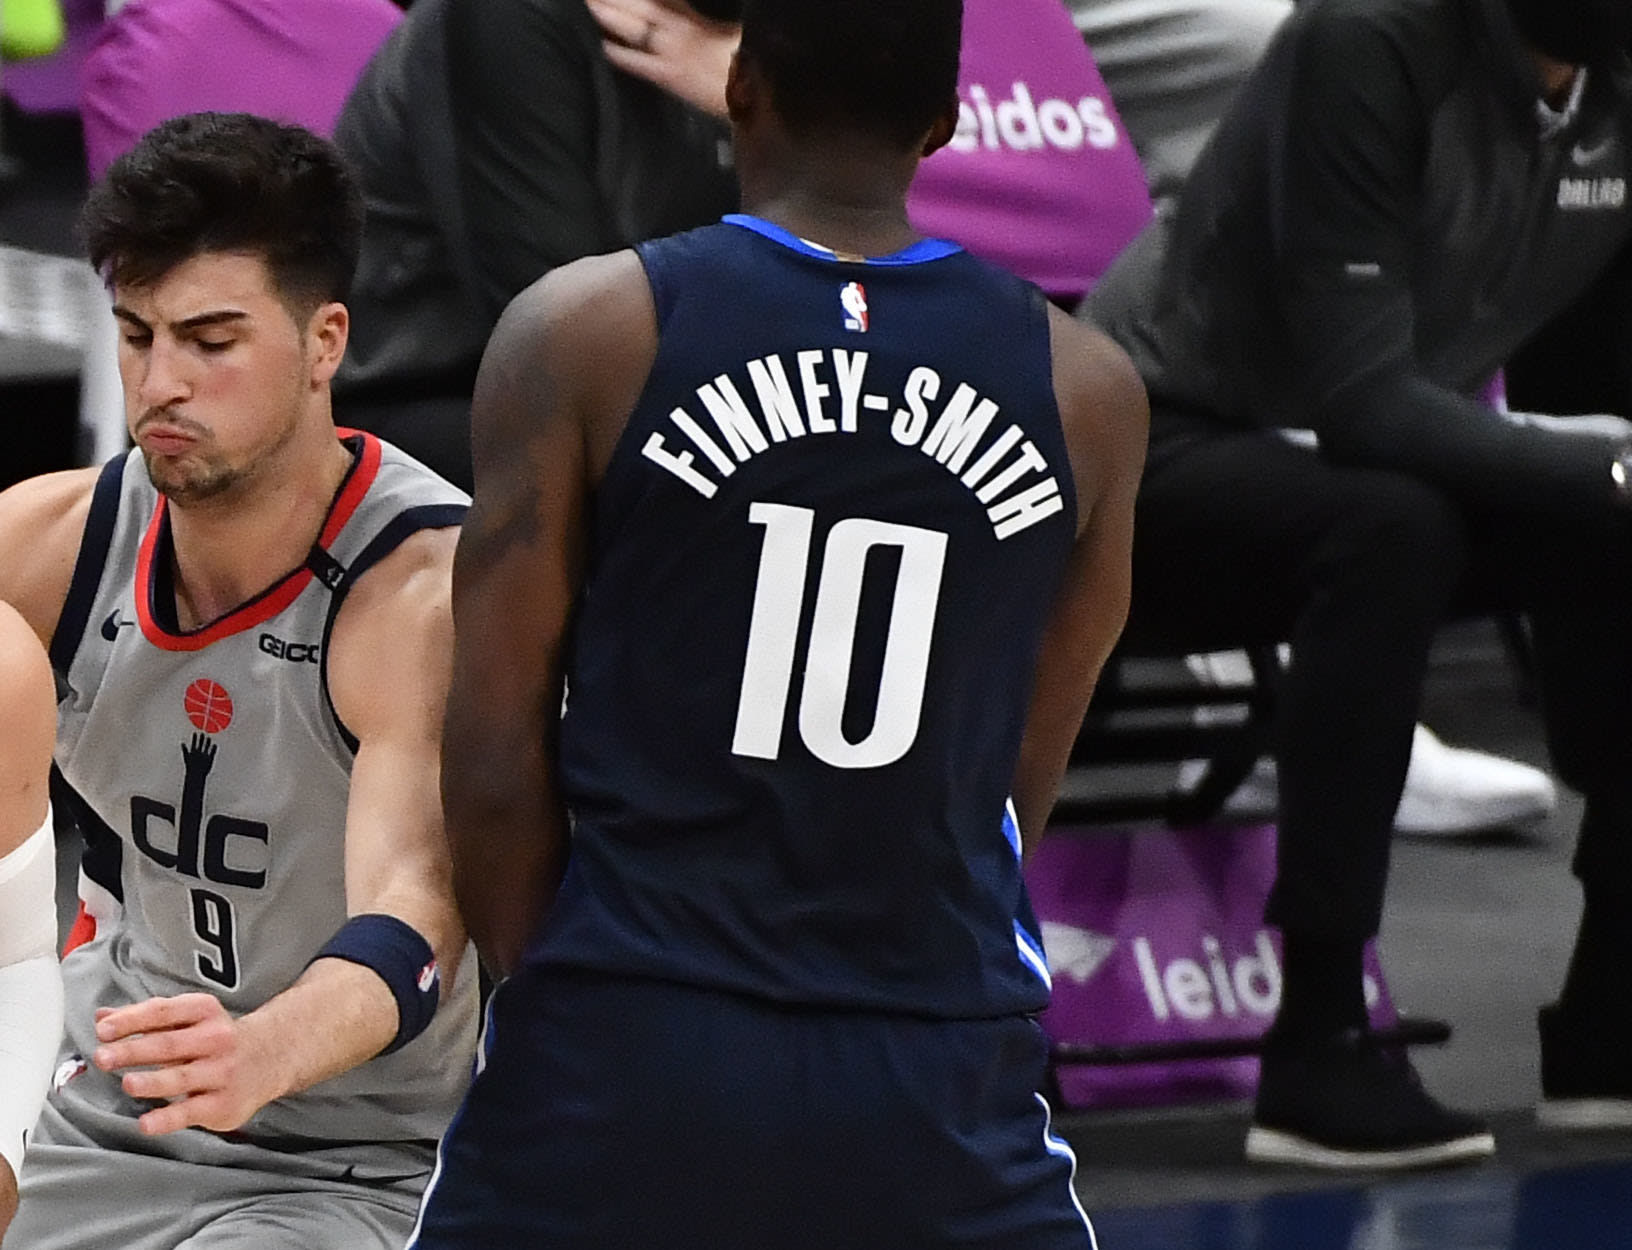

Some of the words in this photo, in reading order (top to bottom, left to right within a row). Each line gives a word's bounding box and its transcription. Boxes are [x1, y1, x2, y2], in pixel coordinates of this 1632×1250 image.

[641, 348, 1064, 541] FINNEY-SMITH
[731, 502, 949, 768] 10
[189, 886, 239, 991] 9
